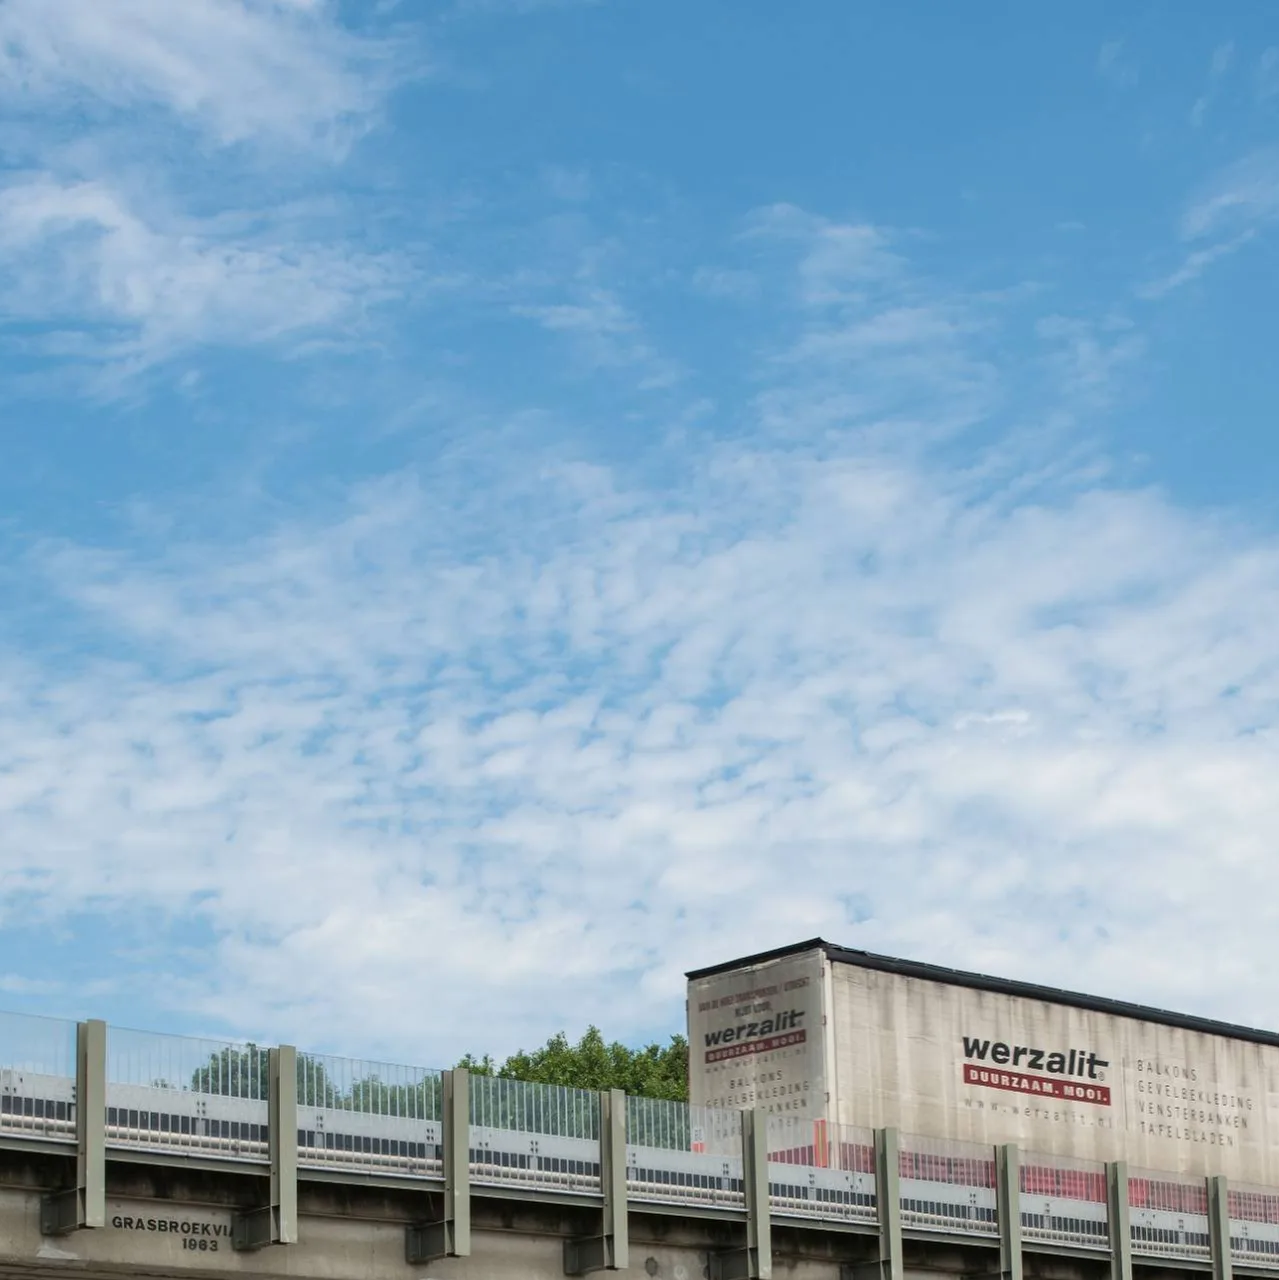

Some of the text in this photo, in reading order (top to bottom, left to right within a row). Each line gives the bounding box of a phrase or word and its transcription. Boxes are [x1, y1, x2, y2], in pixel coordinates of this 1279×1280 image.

[704, 1009, 806, 1048] werzalit
[962, 1036, 1110, 1080] werzalit
[1137, 1059, 1197, 1082] BALKONS
[969, 1069, 1108, 1102] DUURZAAM. MOOI.
[1138, 1080, 1253, 1111] GEVELBEKLEDING
[1138, 1099, 1248, 1129] VENSTERBANKEN
[1140, 1121, 1233, 1147] TAFELBLADEN
[182, 1238, 219, 1251] 1963
